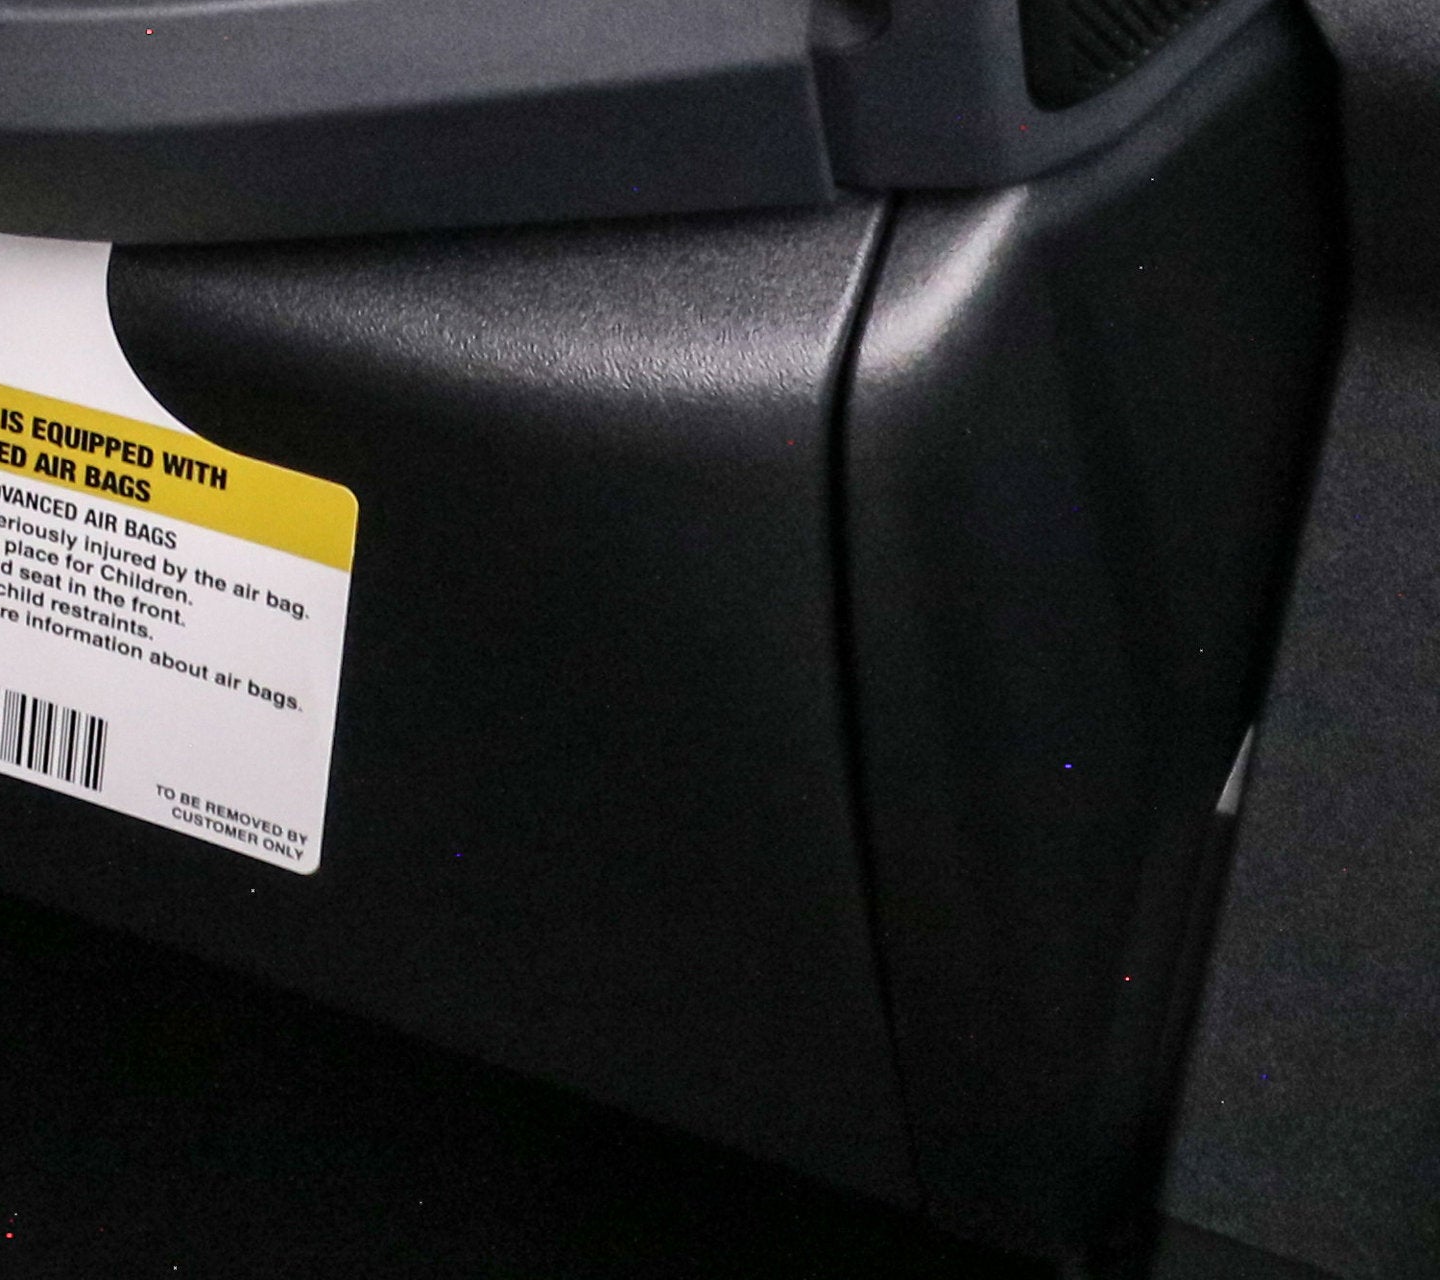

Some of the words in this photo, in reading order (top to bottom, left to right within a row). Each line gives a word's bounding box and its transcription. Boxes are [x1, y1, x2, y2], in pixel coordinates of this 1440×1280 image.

[0, 408, 25, 433] IS
[32, 417, 154, 469] EQUIPPED
[163, 451, 228, 490] WITH
[34, 453, 77, 482] AIR
[85, 466, 152, 503] BAGS
[84, 509, 118, 533] AIR
[124, 519, 178, 550] BAGS
[4, 537, 60, 567] place
[65, 553, 94, 576] for
[101, 564, 193, 607] Children.
[19, 568, 62, 590] seat
[68, 578, 86, 595] in
[93, 585, 126, 608] the
[131, 596, 186, 628] front.
[84, 538, 156, 572] injured
[163, 561, 188, 582] by
[194, 568, 227, 592] the
[233, 581, 260, 603] air
[266, 590, 310, 621] bag.
[51, 598, 154, 641] restraints.
[26, 611, 143, 660] information
[149, 650, 209, 680] about
[215, 671, 241, 691] air
[248, 678, 304, 712] bags.
[156, 784, 176, 800] TO
[180, 792, 201, 809] BE
[205, 800, 283, 837] REMOVED
[287, 829, 308, 846] BY
[171, 806, 258, 846] CUSTOMER
[263, 837, 304, 861] ONLY
